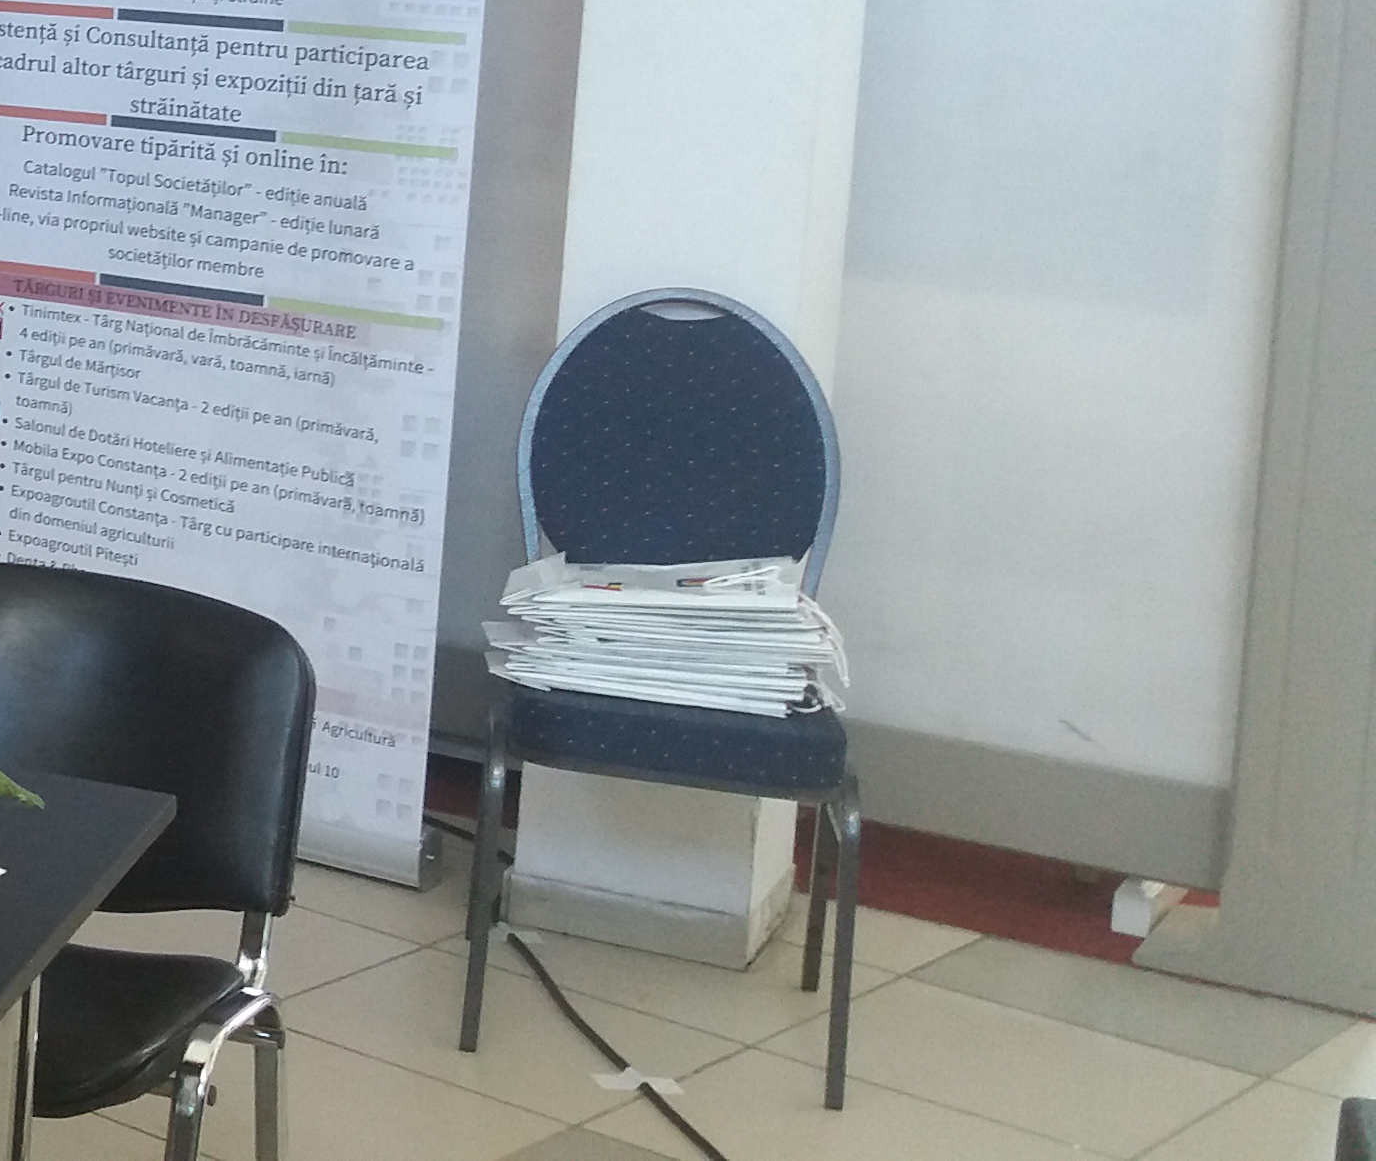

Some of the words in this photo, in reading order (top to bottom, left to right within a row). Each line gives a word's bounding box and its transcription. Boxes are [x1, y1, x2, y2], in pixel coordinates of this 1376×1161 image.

[215, 41, 288, 60] pentru
[294, 44, 430, 72] participarea
[62, 57, 112, 77] altor
[116, 60, 186, 86] târguri
[313, 77, 347, 98] din
[130, 97, 242, 123] străinătate
[21, 125, 135, 153] Promovare
[140, 136, 216, 161] tipărită
[245, 148, 314, 172] online
[319, 153, 348, 175] în:
[196, 260, 265, 278] membre
[13, 279, 84, 300] TÂRGURI
[106, 291, 213, 319] EVENIMENTE
[215, 304, 235, 321] ÎN
[19, 349, 62, 369] Târgul
[64, 356, 82, 370] de
[14, 416, 66, 437] Salonul
[68, 425, 86, 440] de
[88, 428, 130, 448] Dotări
[133, 436, 197, 460] Hoteliere
[301, 465, 355, 489] Publică
[8, 529, 92, 558] Expoagroutil
[322, 720, 396, 748] Agricultură
[324, 763, 340, 779] 10
